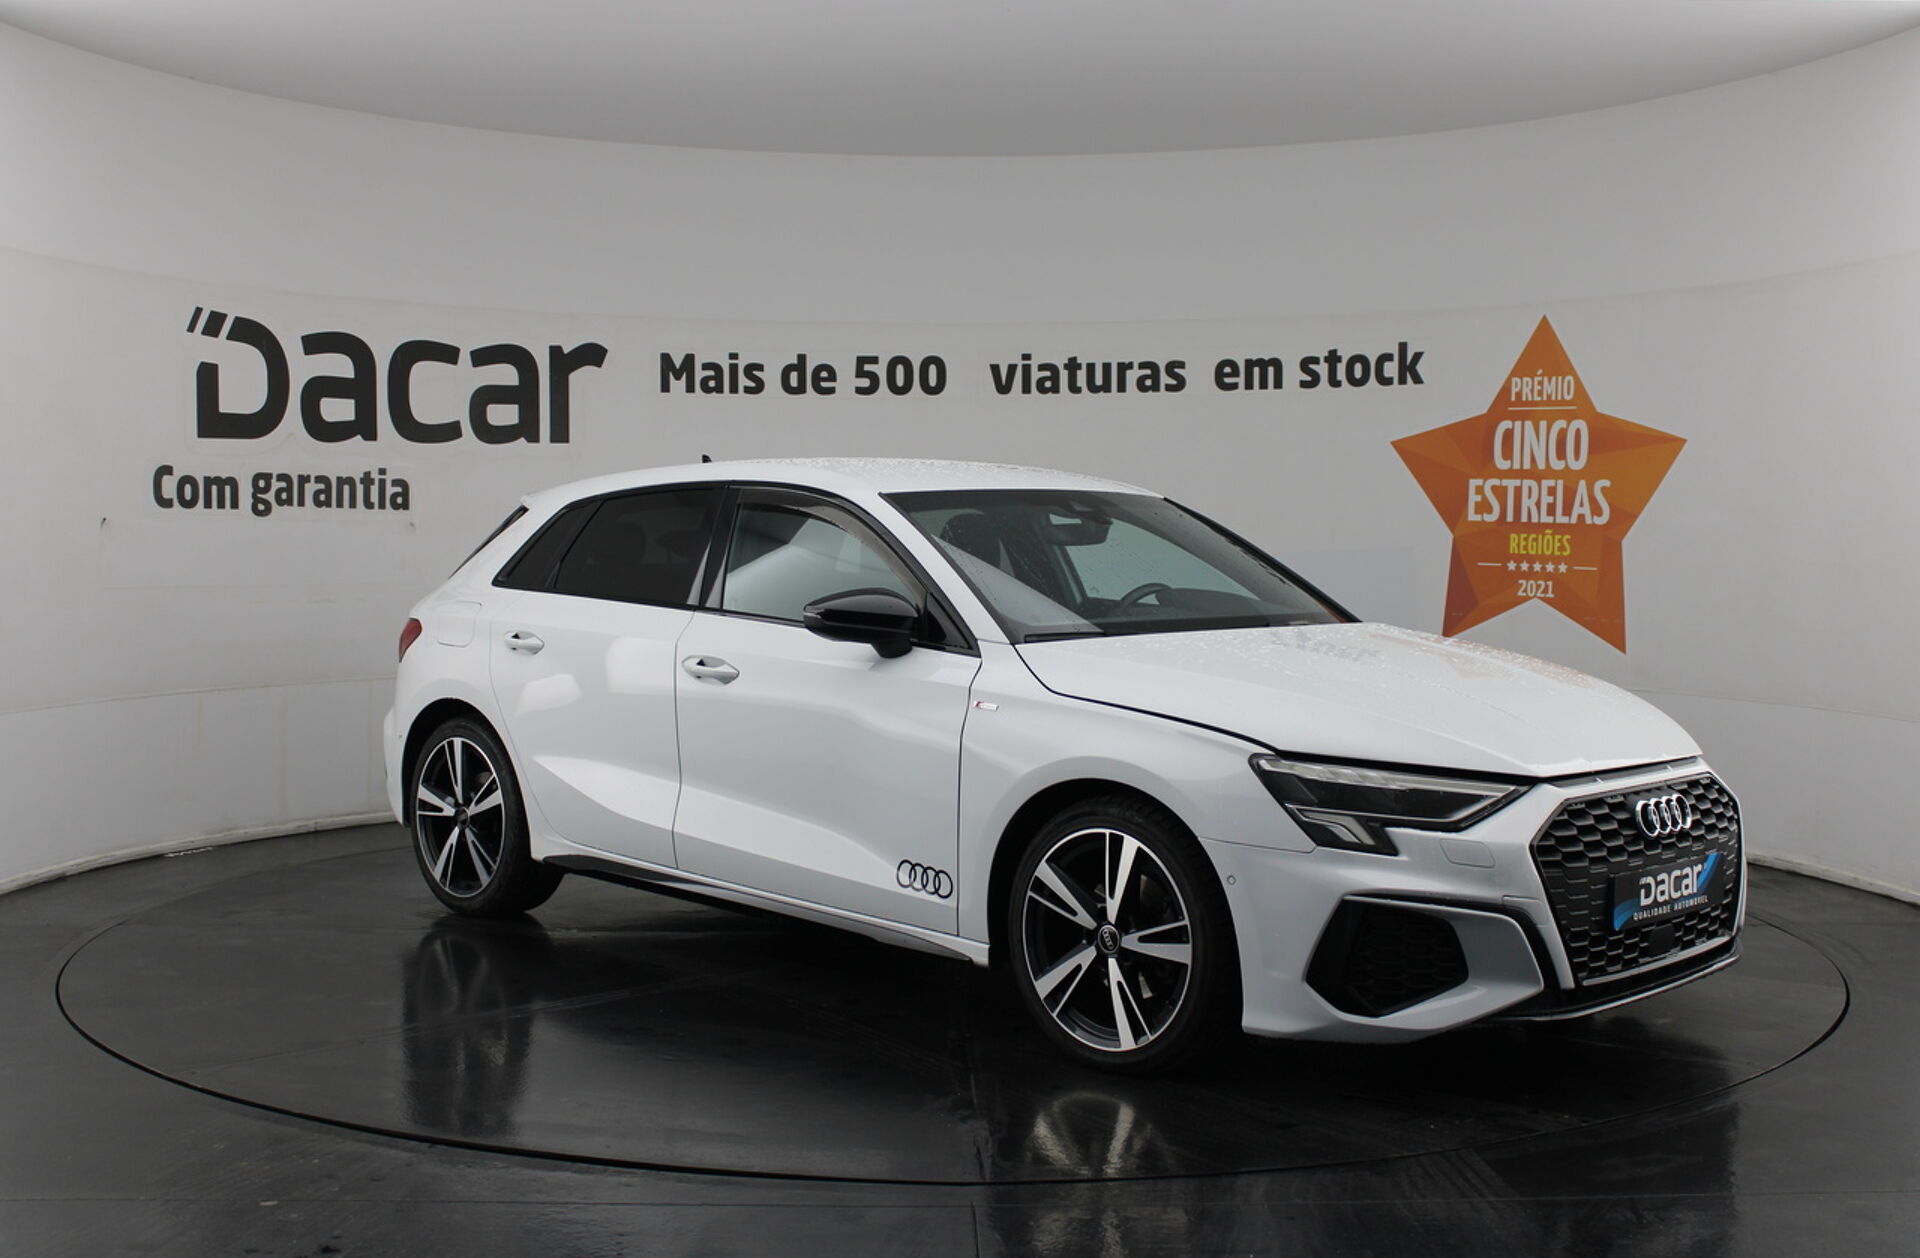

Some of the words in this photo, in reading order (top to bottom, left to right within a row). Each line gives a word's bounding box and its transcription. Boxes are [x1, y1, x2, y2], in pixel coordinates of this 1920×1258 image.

[187, 307, 608, 444] Dacar
[659, 353, 765, 394] Mais
[780, 354, 837, 395] de
[855, 356, 947, 395] 500
[990, 354, 1187, 394] viaturas
[1214, 358, 1284, 392] em
[1299, 342, 1425, 388] stock
[1511, 369, 1575, 401] PRÉMIO
[1493, 419, 1589, 471] CINCO
[153, 464, 240, 509] Com
[251, 467, 410, 517] garantia
[1467, 479, 1611, 525] ESTRELAS
[1509, 529, 1571, 556] REGIÕES
[1517, 579, 1555, 598] 2021
[1639, 863, 1702, 906] Dacar
